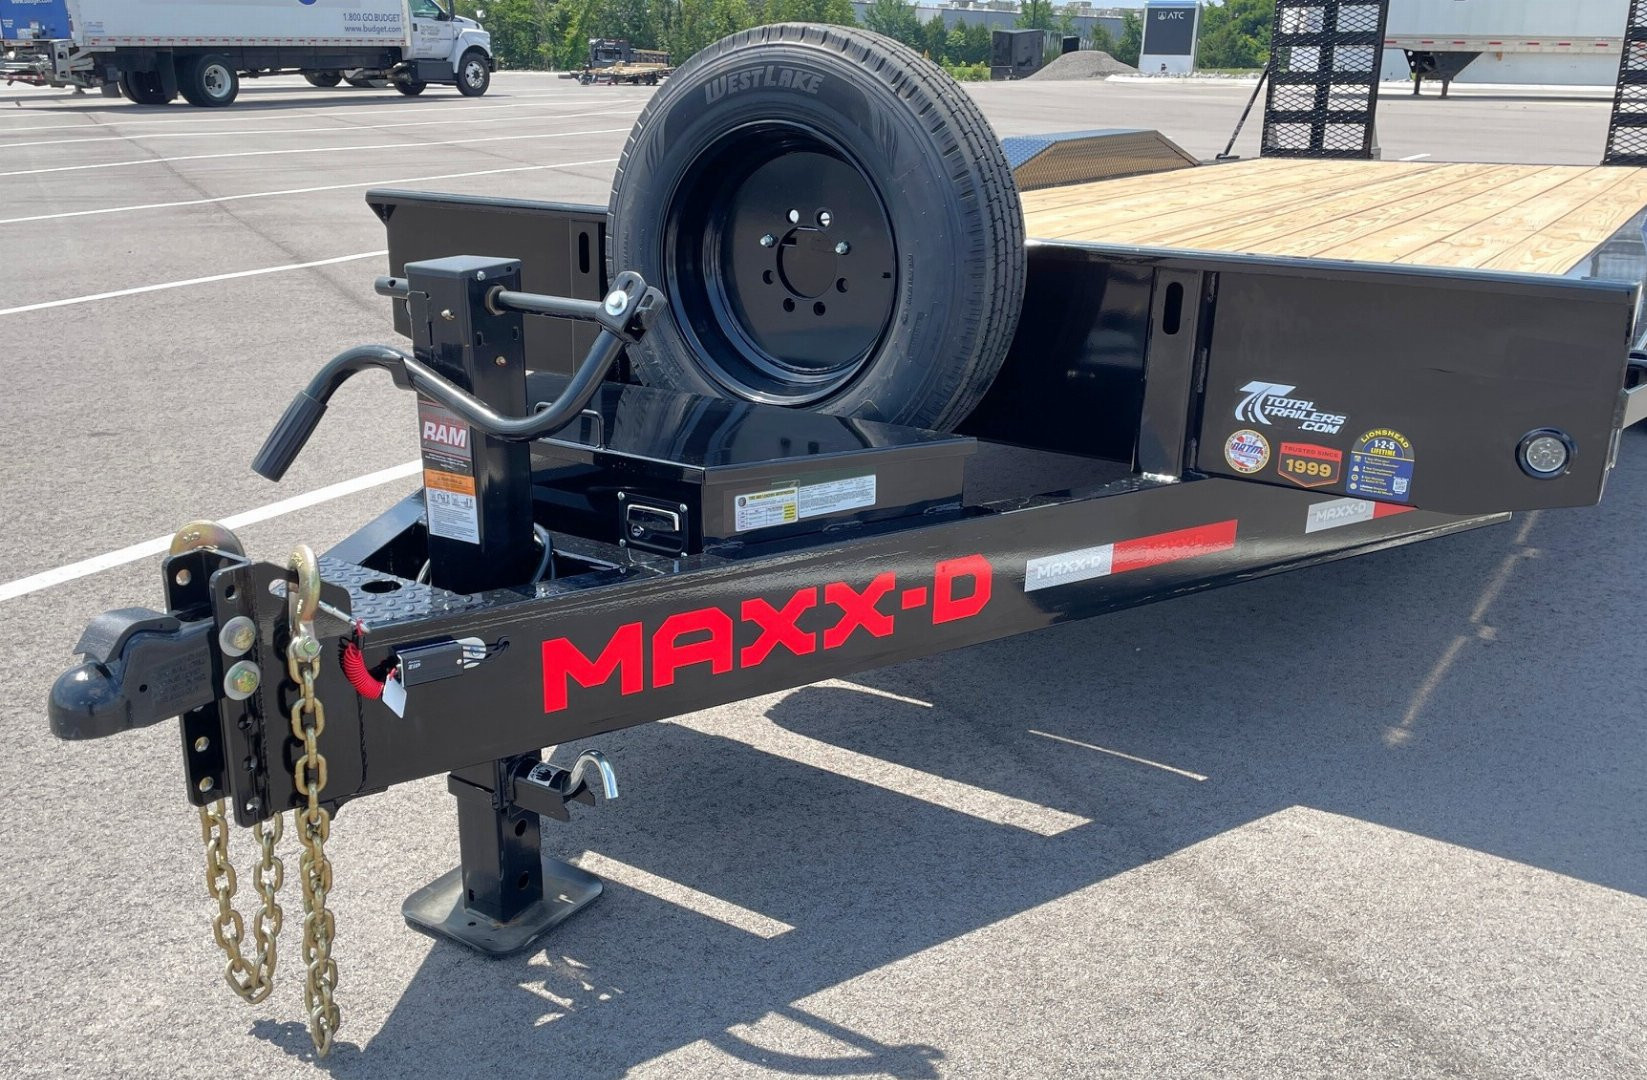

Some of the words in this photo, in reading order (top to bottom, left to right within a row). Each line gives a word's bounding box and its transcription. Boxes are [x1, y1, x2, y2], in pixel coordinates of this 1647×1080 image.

[1167, 11, 1184, 19] ATC
[345, 24, 401, 34] www.budget.com
[1267, 396, 1317, 412] TOTAL
[1264, 406, 1346, 425] TRAILERS
[423, 421, 467, 448] RAM
[1298, 421, 1340, 435] .COM
[1361, 429, 1409, 449] LIONSHEAD
[1284, 445, 1316, 455] TRUSTED
[1371, 448, 1396, 457] LIFETIME
[1286, 459, 1332, 478] 1999
[1316, 503, 1366, 522] MAXX-D
[1037, 555, 1101, 579] MAXX-D
[542, 553, 992, 713] MAXX-D
